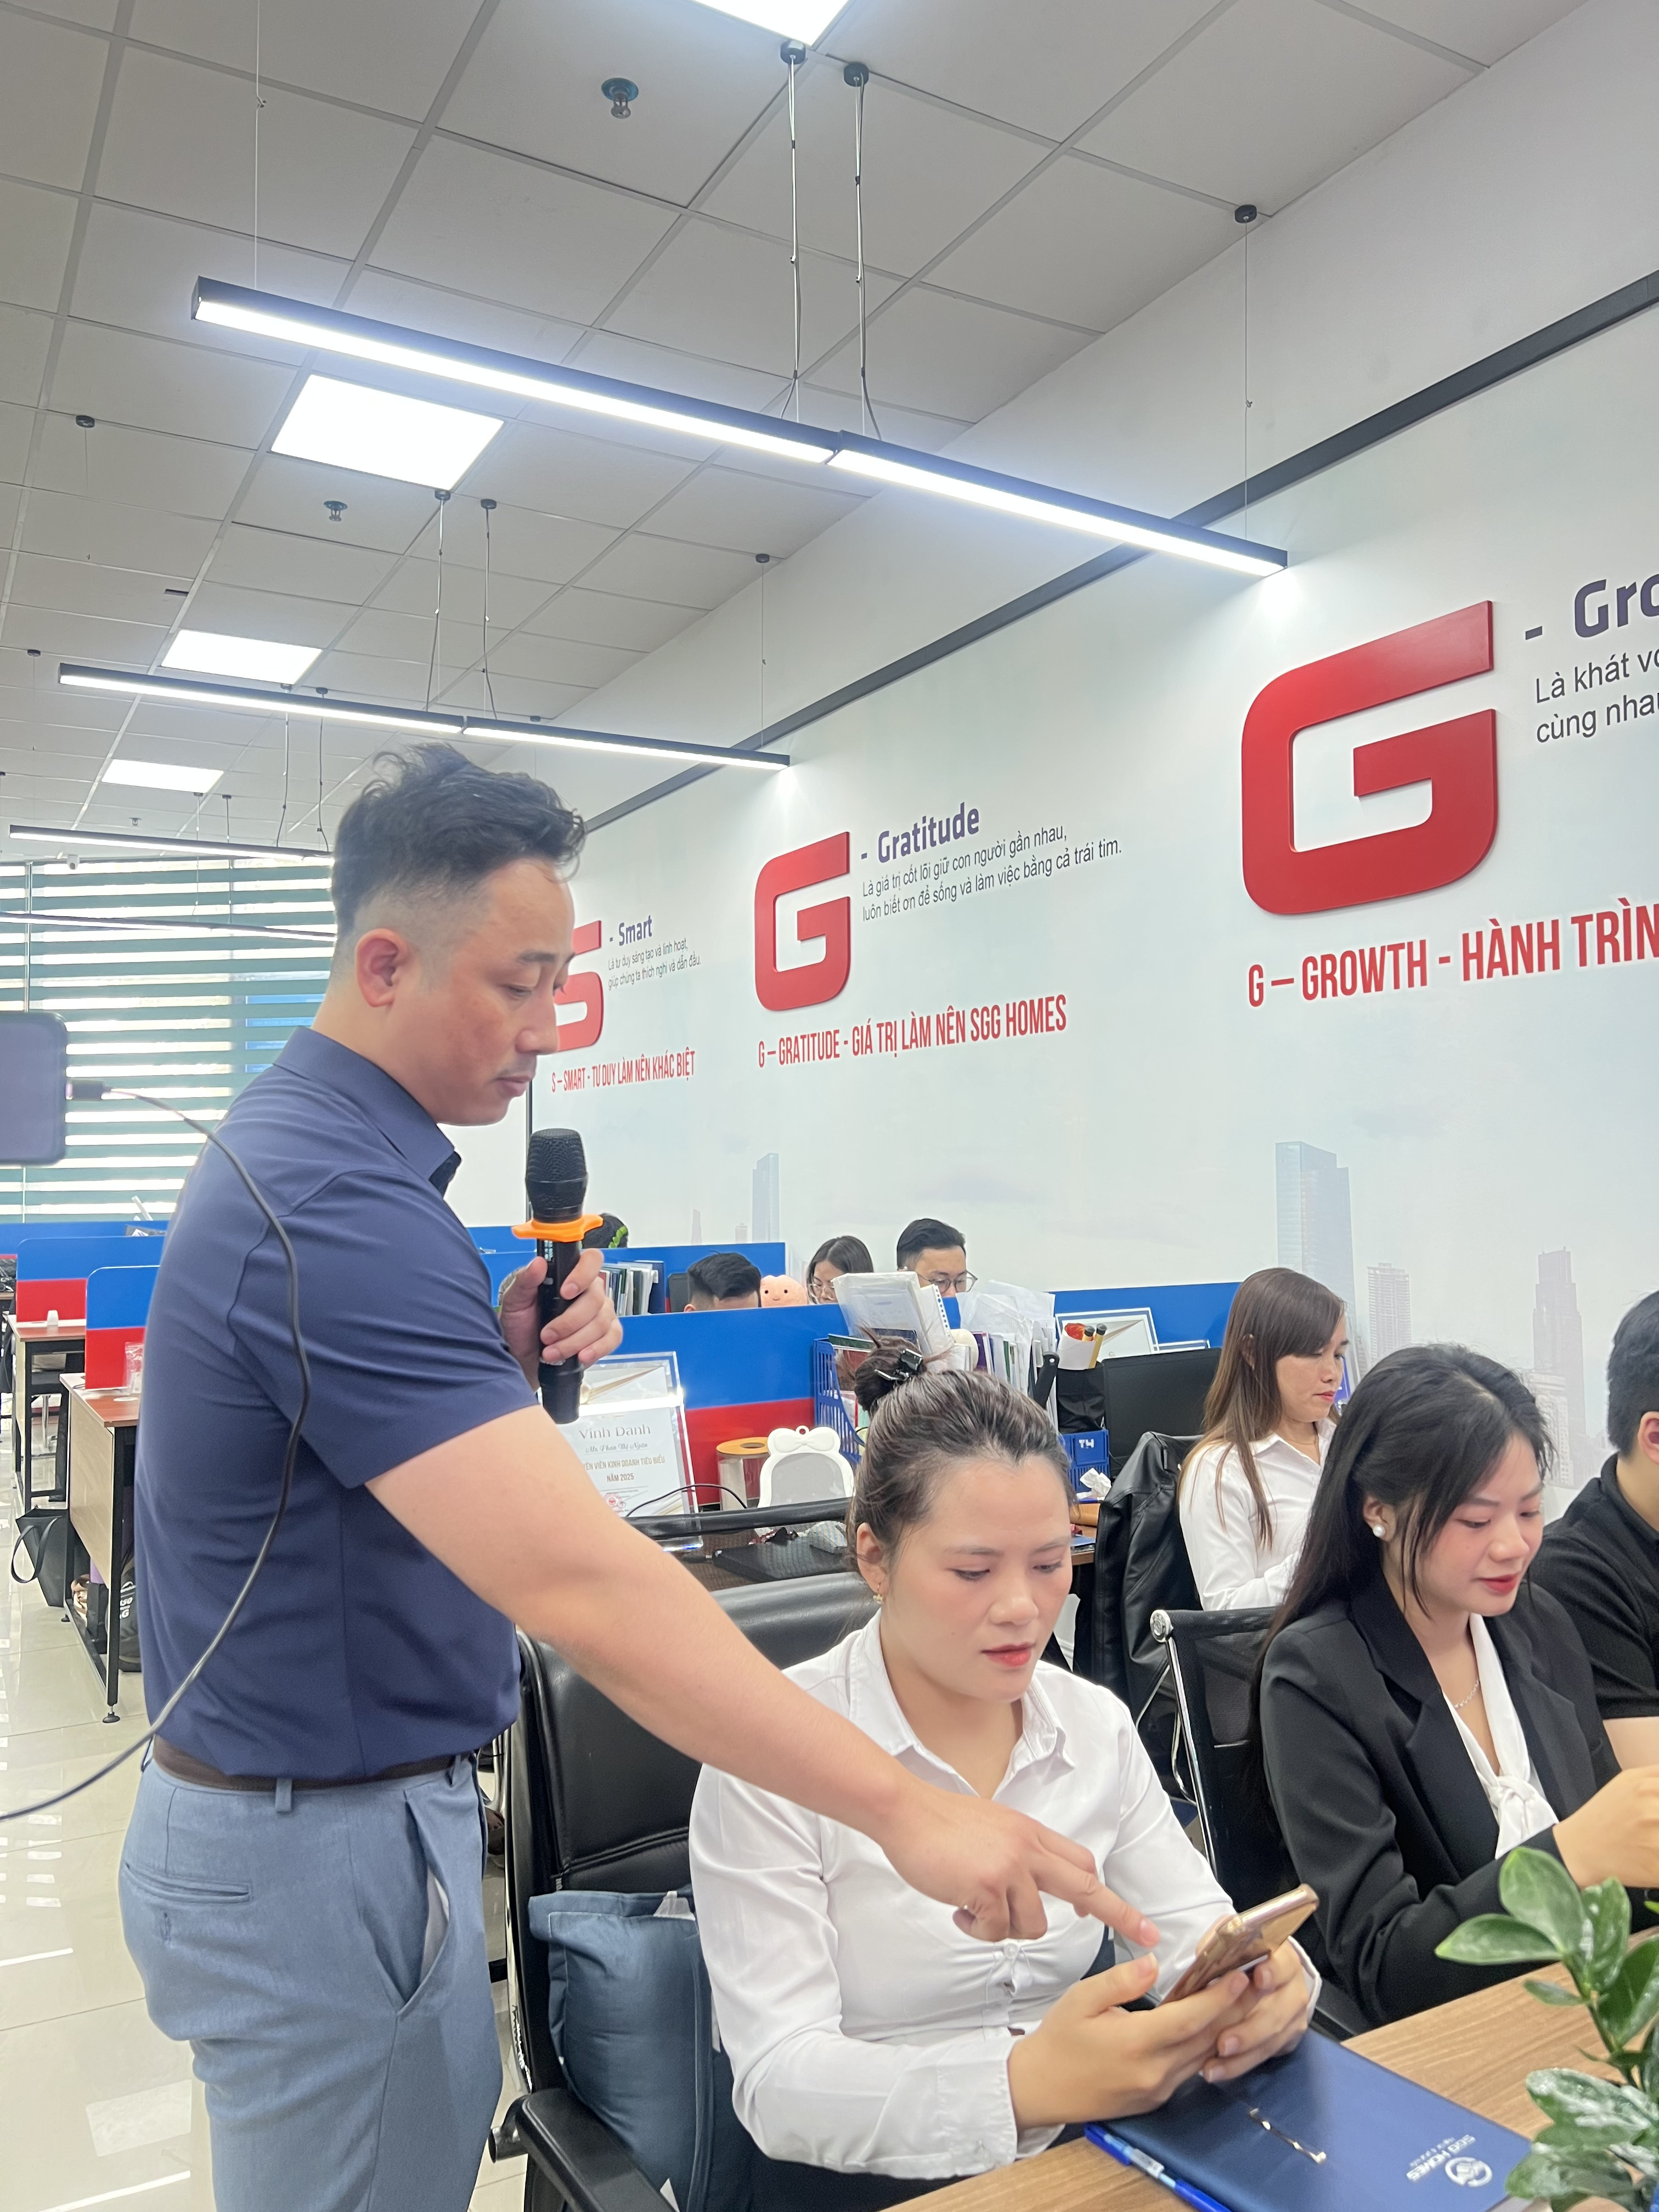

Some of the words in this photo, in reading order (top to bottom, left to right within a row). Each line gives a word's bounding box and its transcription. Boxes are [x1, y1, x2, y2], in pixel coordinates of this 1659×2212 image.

[1536, 672, 1565, 704] Là
[1575, 652, 1630, 692] khát
[1537, 710, 1596, 743] cùng
[1606, 692, 1659, 726] nha
[1242, 600, 1498, 915] G
[878, 802, 979, 864] Gratitude
[862, 880, 873, 897] Là
[876, 874, 889, 896] giá
[892, 872, 901, 890] trị
[903, 864, 917, 885] cốt
[920, 861, 930, 881] lõi
[933, 857, 950, 880] giữ
[952, 854, 970, 871] con
[974, 839, 1006, 867] người
[1009, 831, 1030, 858] gần
[1034, 826, 1066, 847] nhau,
[862, 904, 881, 922] luôn
[884, 894, 900, 916] biết
[903, 896, 916, 911] ơn
[918, 884, 930, 906] để
[933, 881, 957, 902] sống
[960, 877, 972, 895] và
[975, 873, 994, 891] làm
[998, 865, 1020, 887] việc
[1024, 855, 1052, 877] bằng
[1056, 848, 1070, 869] cả
[1075, 842, 1093, 865] trái
[1098, 838, 1121, 858] tim.
[619, 915, 652, 946] Smart
[755, 831, 851, 1011] G
[632, 951, 644, 964] sáng
[645, 949, 653, 962] tạo
[655, 944, 661, 957] và
[636, 970, 640, 981] ta
[656, 962, 667, 978] nghi
[669, 959, 675, 972] và
[677, 955, 687, 970] dẫn
[1249, 964, 1264, 1007] G
[1302, 939, 1427, 1001] GROWTH
[1462, 918, 1560, 981] HÀNH
[779, 1029, 840, 1065] GRATITUDE
[852, 1018, 873, 1056] GIÁ
[877, 1020, 897, 1058] TRỊ
[902, 1011, 931, 1050] LÀM
[936, 1005, 966, 1046] NÊN
[970, 1005, 1001, 1041] SGG
[1006, 994, 1066, 1037] HOMES
[563, 1068, 585, 1091] SMART
[602, 1063, 616, 1086] DUY
[618, 1057, 633, 1084] LÀM
[635, 1053, 650, 1082] NÊN
[652, 1049, 674, 1080] KHÁC
[676, 1046, 695, 1081] BIỆT
[579, 1427, 611, 1440] Vinh
[616, 1424, 651, 1436] Danh
[620, 1473, 634, 1481] 2025
